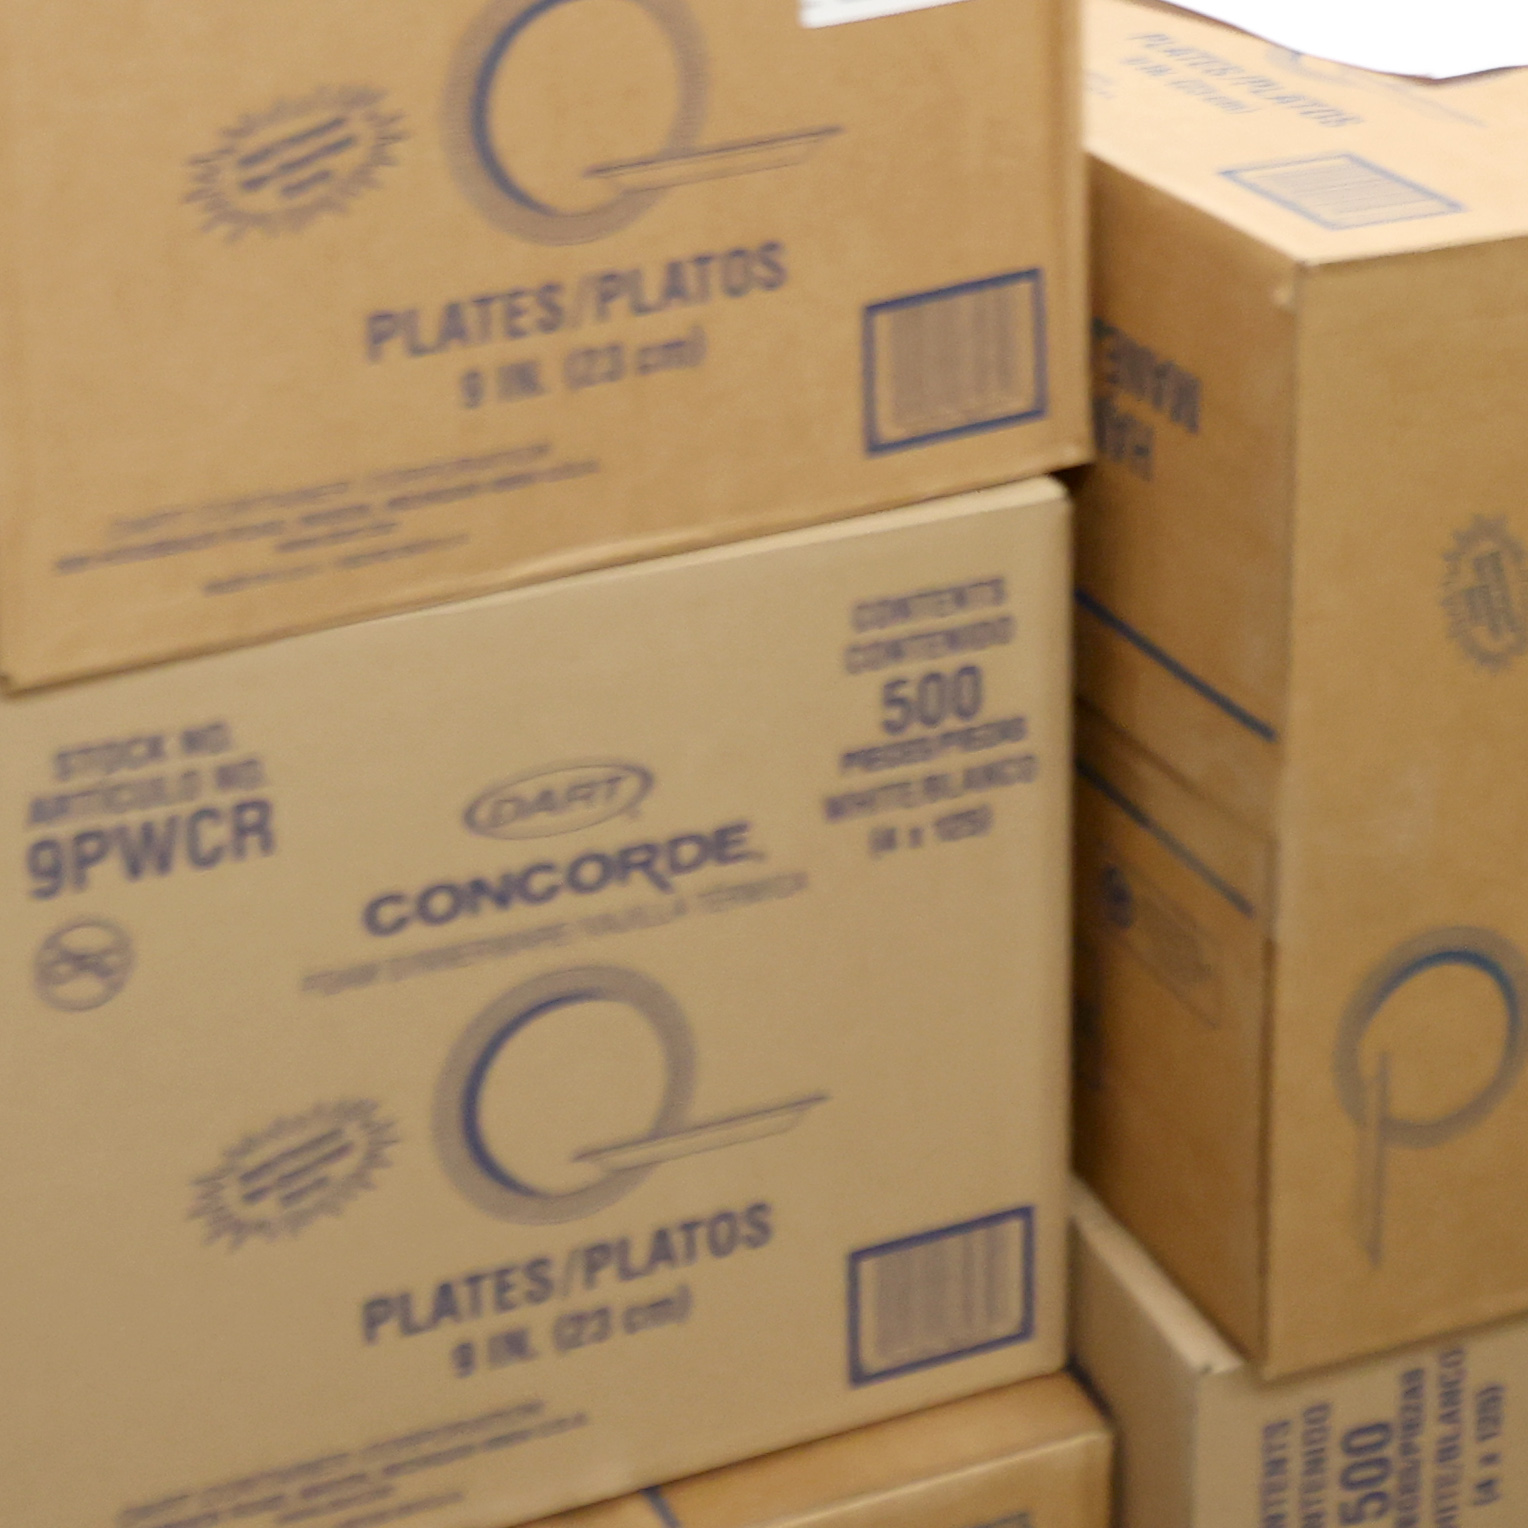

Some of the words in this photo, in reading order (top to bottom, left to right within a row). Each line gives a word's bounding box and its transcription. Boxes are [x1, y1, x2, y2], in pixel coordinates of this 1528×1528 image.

[366, 241, 789, 364] PLATES/PLATOS
[459, 369, 485, 409] 9
[563, 340, 625, 391] (23
[633, 326, 707, 377] cm)
[881, 663, 985, 735] 500
[54, 735, 164, 781] STOCK
[488, 775, 624, 830] DART
[26, 800, 276, 901] 9PWCR
[363, 820, 758, 937] CONCORDE
[362, 1202, 771, 1345] PLATES/PLATOS
[452, 1340, 476, 1379] 9
[552, 1306, 614, 1352] (23
[623, 1283, 693, 1337] cm)
[1338, 1421, 1394, 1526] 500
